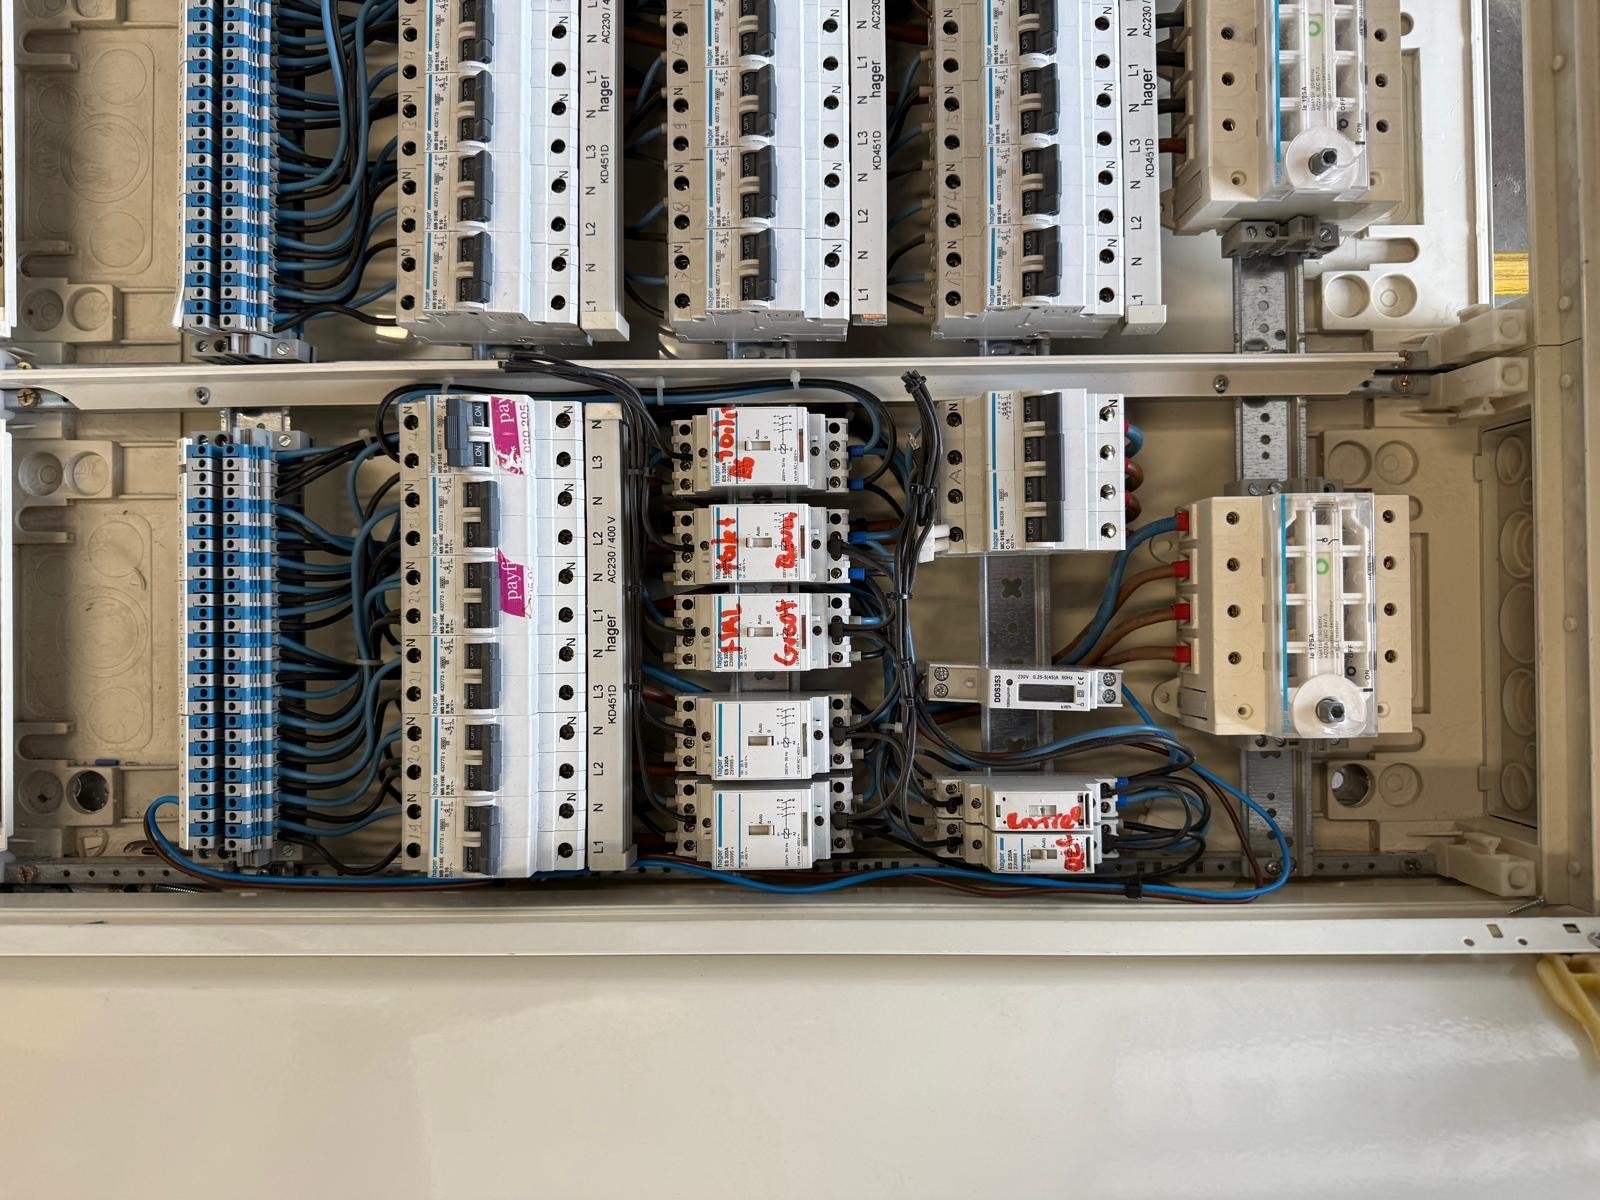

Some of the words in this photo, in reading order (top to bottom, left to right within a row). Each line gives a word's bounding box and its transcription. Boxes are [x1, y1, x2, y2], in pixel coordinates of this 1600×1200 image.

[602, 13, 610, 44] AC230
[857, 56, 867, 68] L1
[1128, 64, 1138, 77] L1
[587, 71, 596, 83] L1
[869, 61, 884, 97] hager
[598, 75, 613, 111] hager
[1141, 69, 1155, 105] hager
[857, 96, 867, 104] N
[586, 110, 596, 118] N
[1129, 104, 1139, 112] N
[1357, 123, 1362, 133] ON
[858, 131, 868, 145] L3
[586, 145, 596, 158] L3
[1130, 139, 1140, 152] L3
[601, 145, 609, 183] KD451D
[1145, 139, 1154, 177] KD451D
[1130, 181, 1140, 189] N
[858, 209, 868, 223] L2
[586, 222, 595, 236] L2
[1131, 216, 1142, 230] L2
[858, 251, 868, 259] N
[858, 289, 868, 301] L1
[1109, 400, 1118, 408] N
[475, 406, 482, 416] ON
[592, 420, 602, 429] N
[475, 446, 482, 457] ON
[592, 456, 602, 469] L3
[593, 497, 602, 505] N
[593, 532, 603, 545] L2
[608, 551, 616, 583] AC230
[593, 610, 603, 622] L1
[605, 615, 619, 652] hager
[593, 649, 603, 657] N
[1365, 669, 1370, 680] ON
[594, 685, 603, 698] L3
[608, 685, 616, 724] KD451D
[406, 717, 415, 725] N
[593, 762, 603, 776] L2
[567, 793, 576, 801] N
[593, 841, 604, 853] L1
